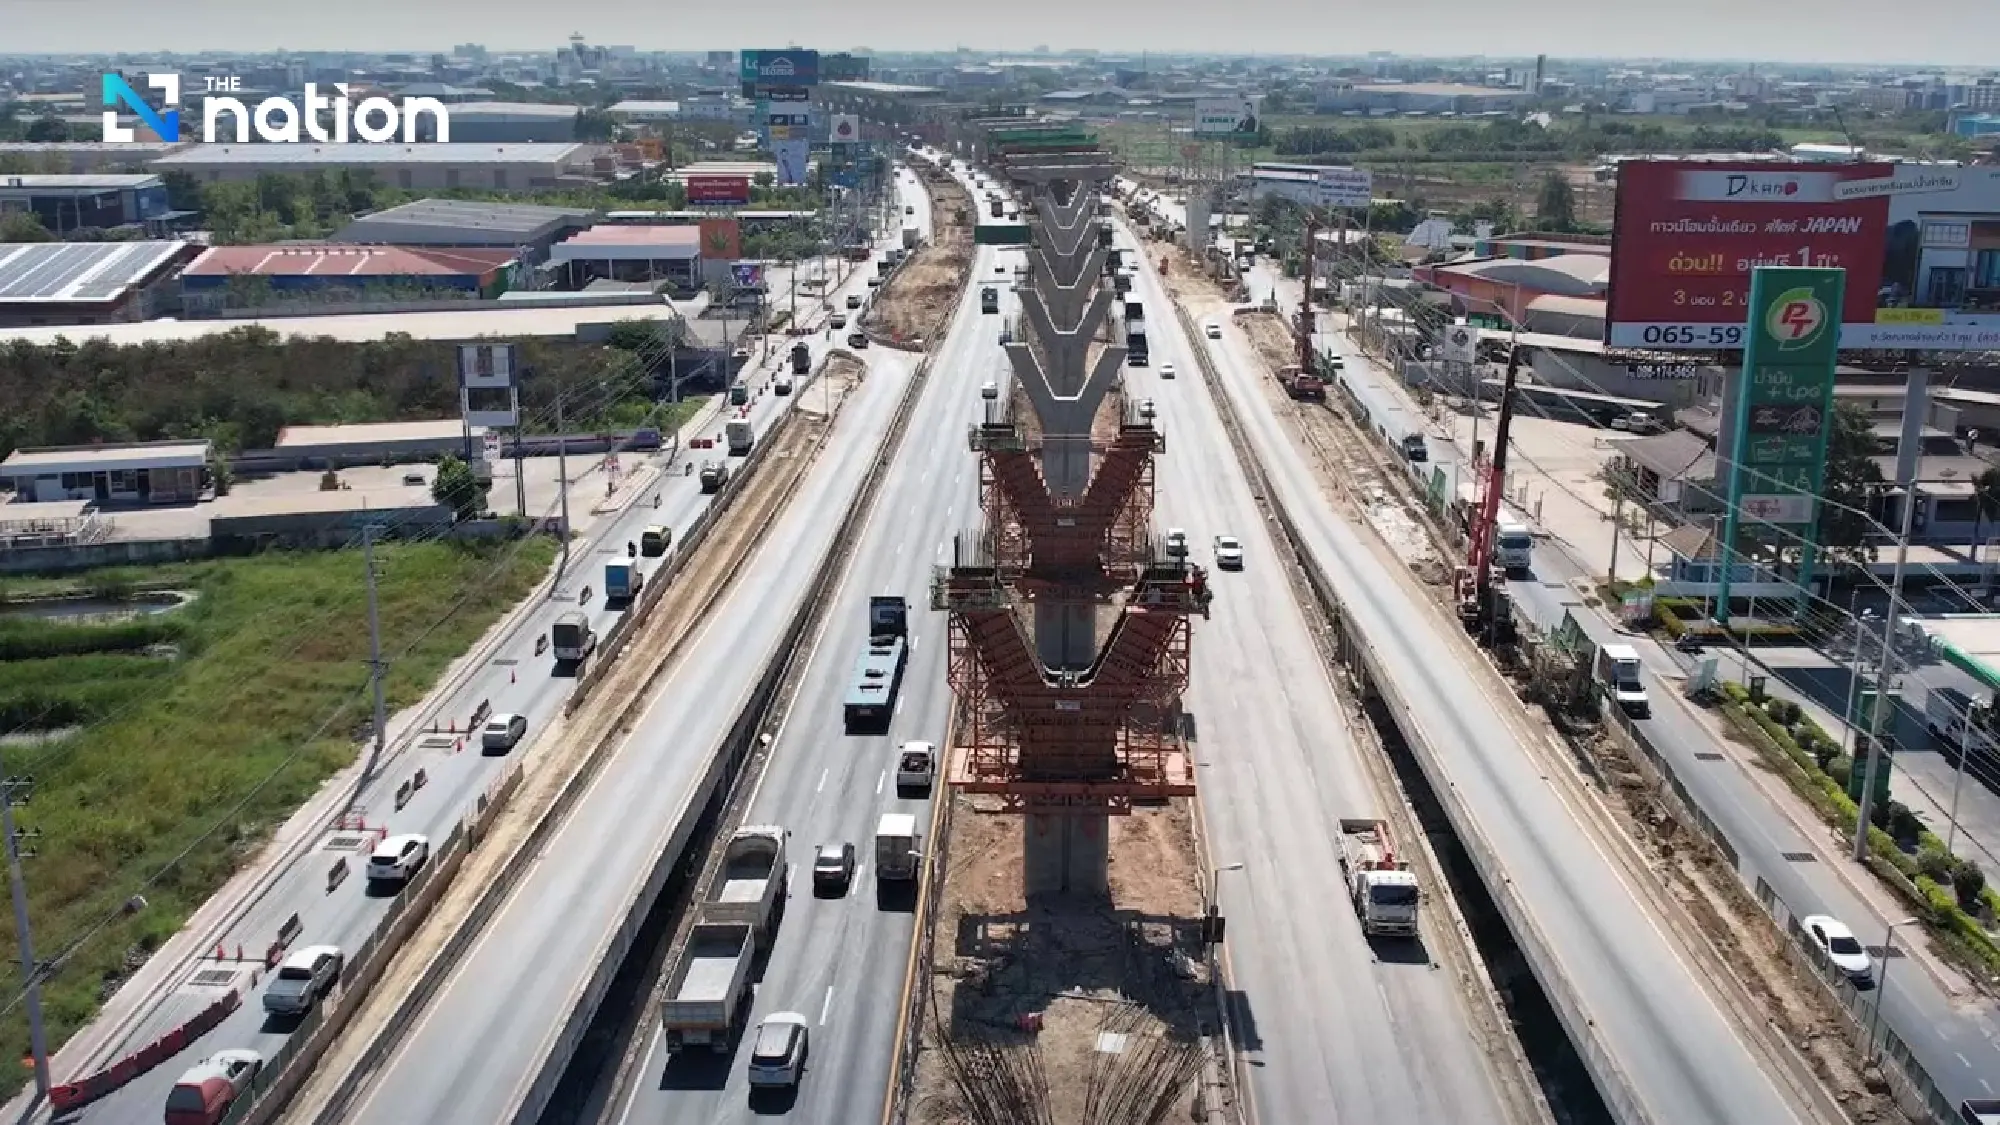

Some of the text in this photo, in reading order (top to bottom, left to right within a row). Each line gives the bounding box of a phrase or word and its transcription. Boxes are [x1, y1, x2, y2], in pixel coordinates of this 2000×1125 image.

[1800, 217, 1862, 235] JAPAN
[1668, 251, 1724, 272] ด่วน!!
[1673, 288, 1687, 305] 3
[1722, 290, 1734, 306] 2
[1781, 302, 1814, 338] PT
[1642, 325, 1748, 344] 065-59
